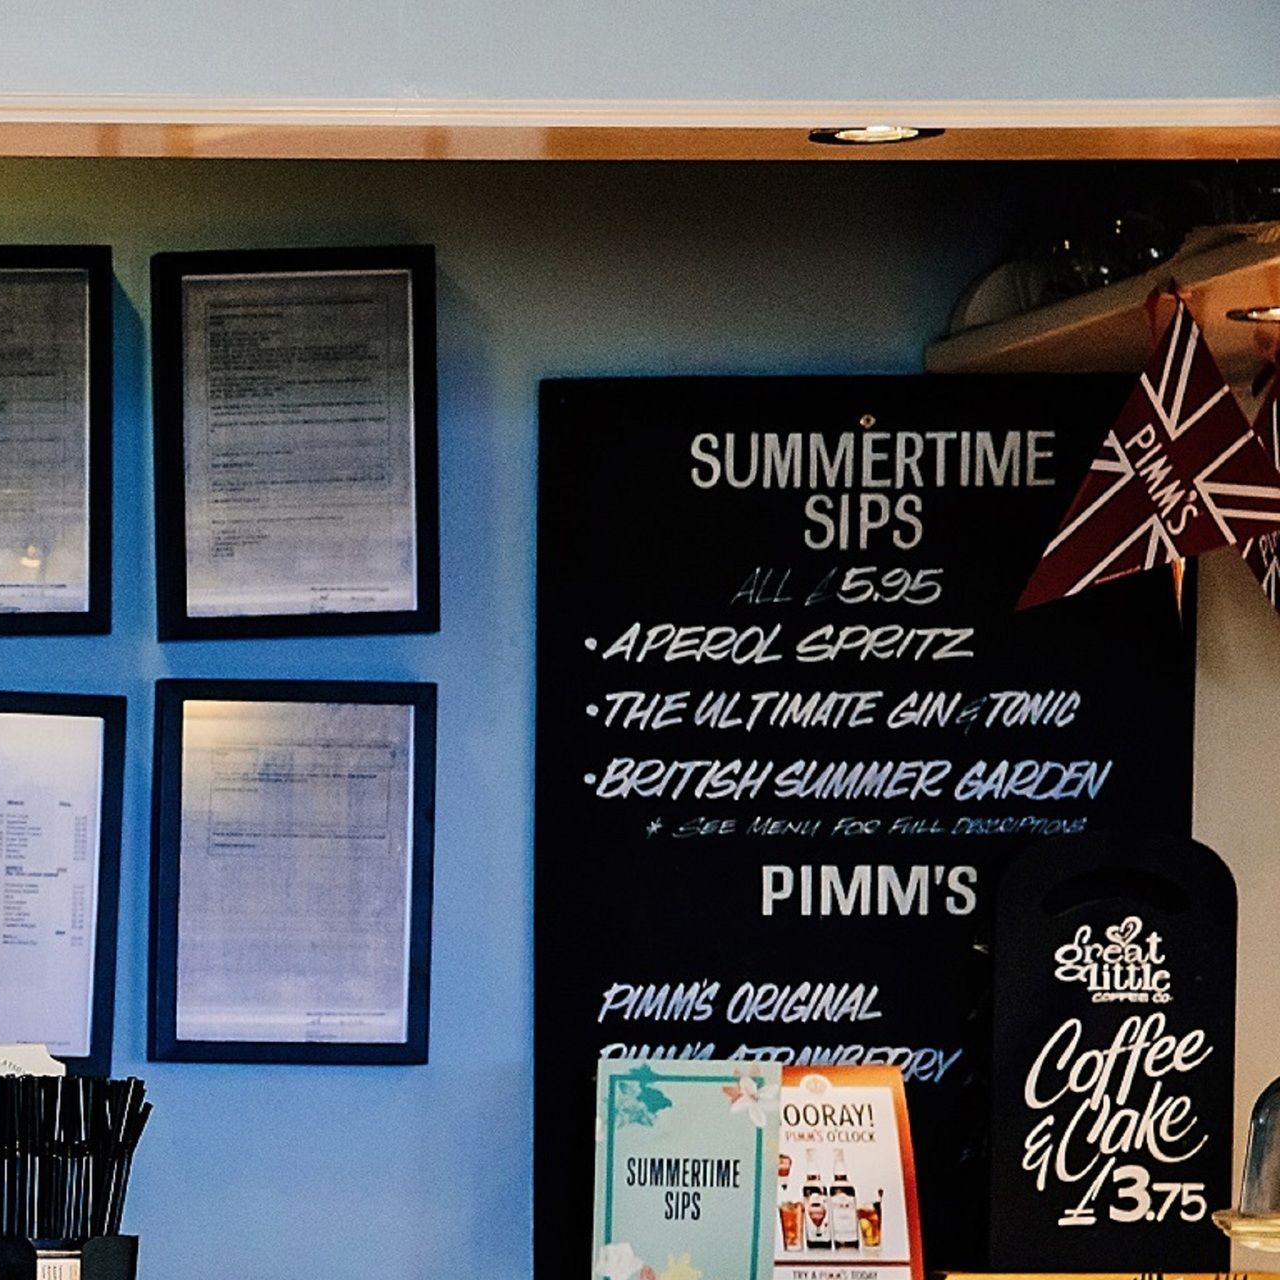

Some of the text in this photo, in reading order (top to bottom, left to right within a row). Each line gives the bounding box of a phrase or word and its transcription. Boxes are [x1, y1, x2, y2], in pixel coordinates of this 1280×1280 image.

[690, 430, 1056, 488] SUMMERTIME
[1124, 423, 1199, 536] PIMM'S
[804, 494, 923, 550] SIPS
[731, 567, 792, 604] ALL
[602, 622, 974, 664] APEROL SPRITZ
[605, 692, 687, 730] THE
[694, 691, 882, 730] ULTIMATE
[888, 691, 962, 728] GIN
[984, 690, 1081, 728] TONIC
[597, 758, 1113, 801] BRITISH SUMMER GARDEN
[673, 817, 737, 838] SEE
[747, 816, 821, 837] MENU
[831, 817, 882, 837] FOR
[761, 864, 978, 916] PIMM'S
[1054, 925, 1165, 982] great
[1087, 963, 1171, 992] little
[1092, 992, 1149, 1003] COFFEE
[598, 978, 882, 1024] PIMM'S ORIGINAL
[1024, 1011, 1214, 1111] Coffee
[780, 1104, 874, 1127] OORAY!
[827, 1129, 876, 1143] O'CLOCK
[1022, 1081, 1209, 1191] & Cake
[626, 1157, 740, 1188] SUMMERTIME
[1058, 1156, 1207, 1226] £3.75
[665, 1191, 701, 1220] SIPS
